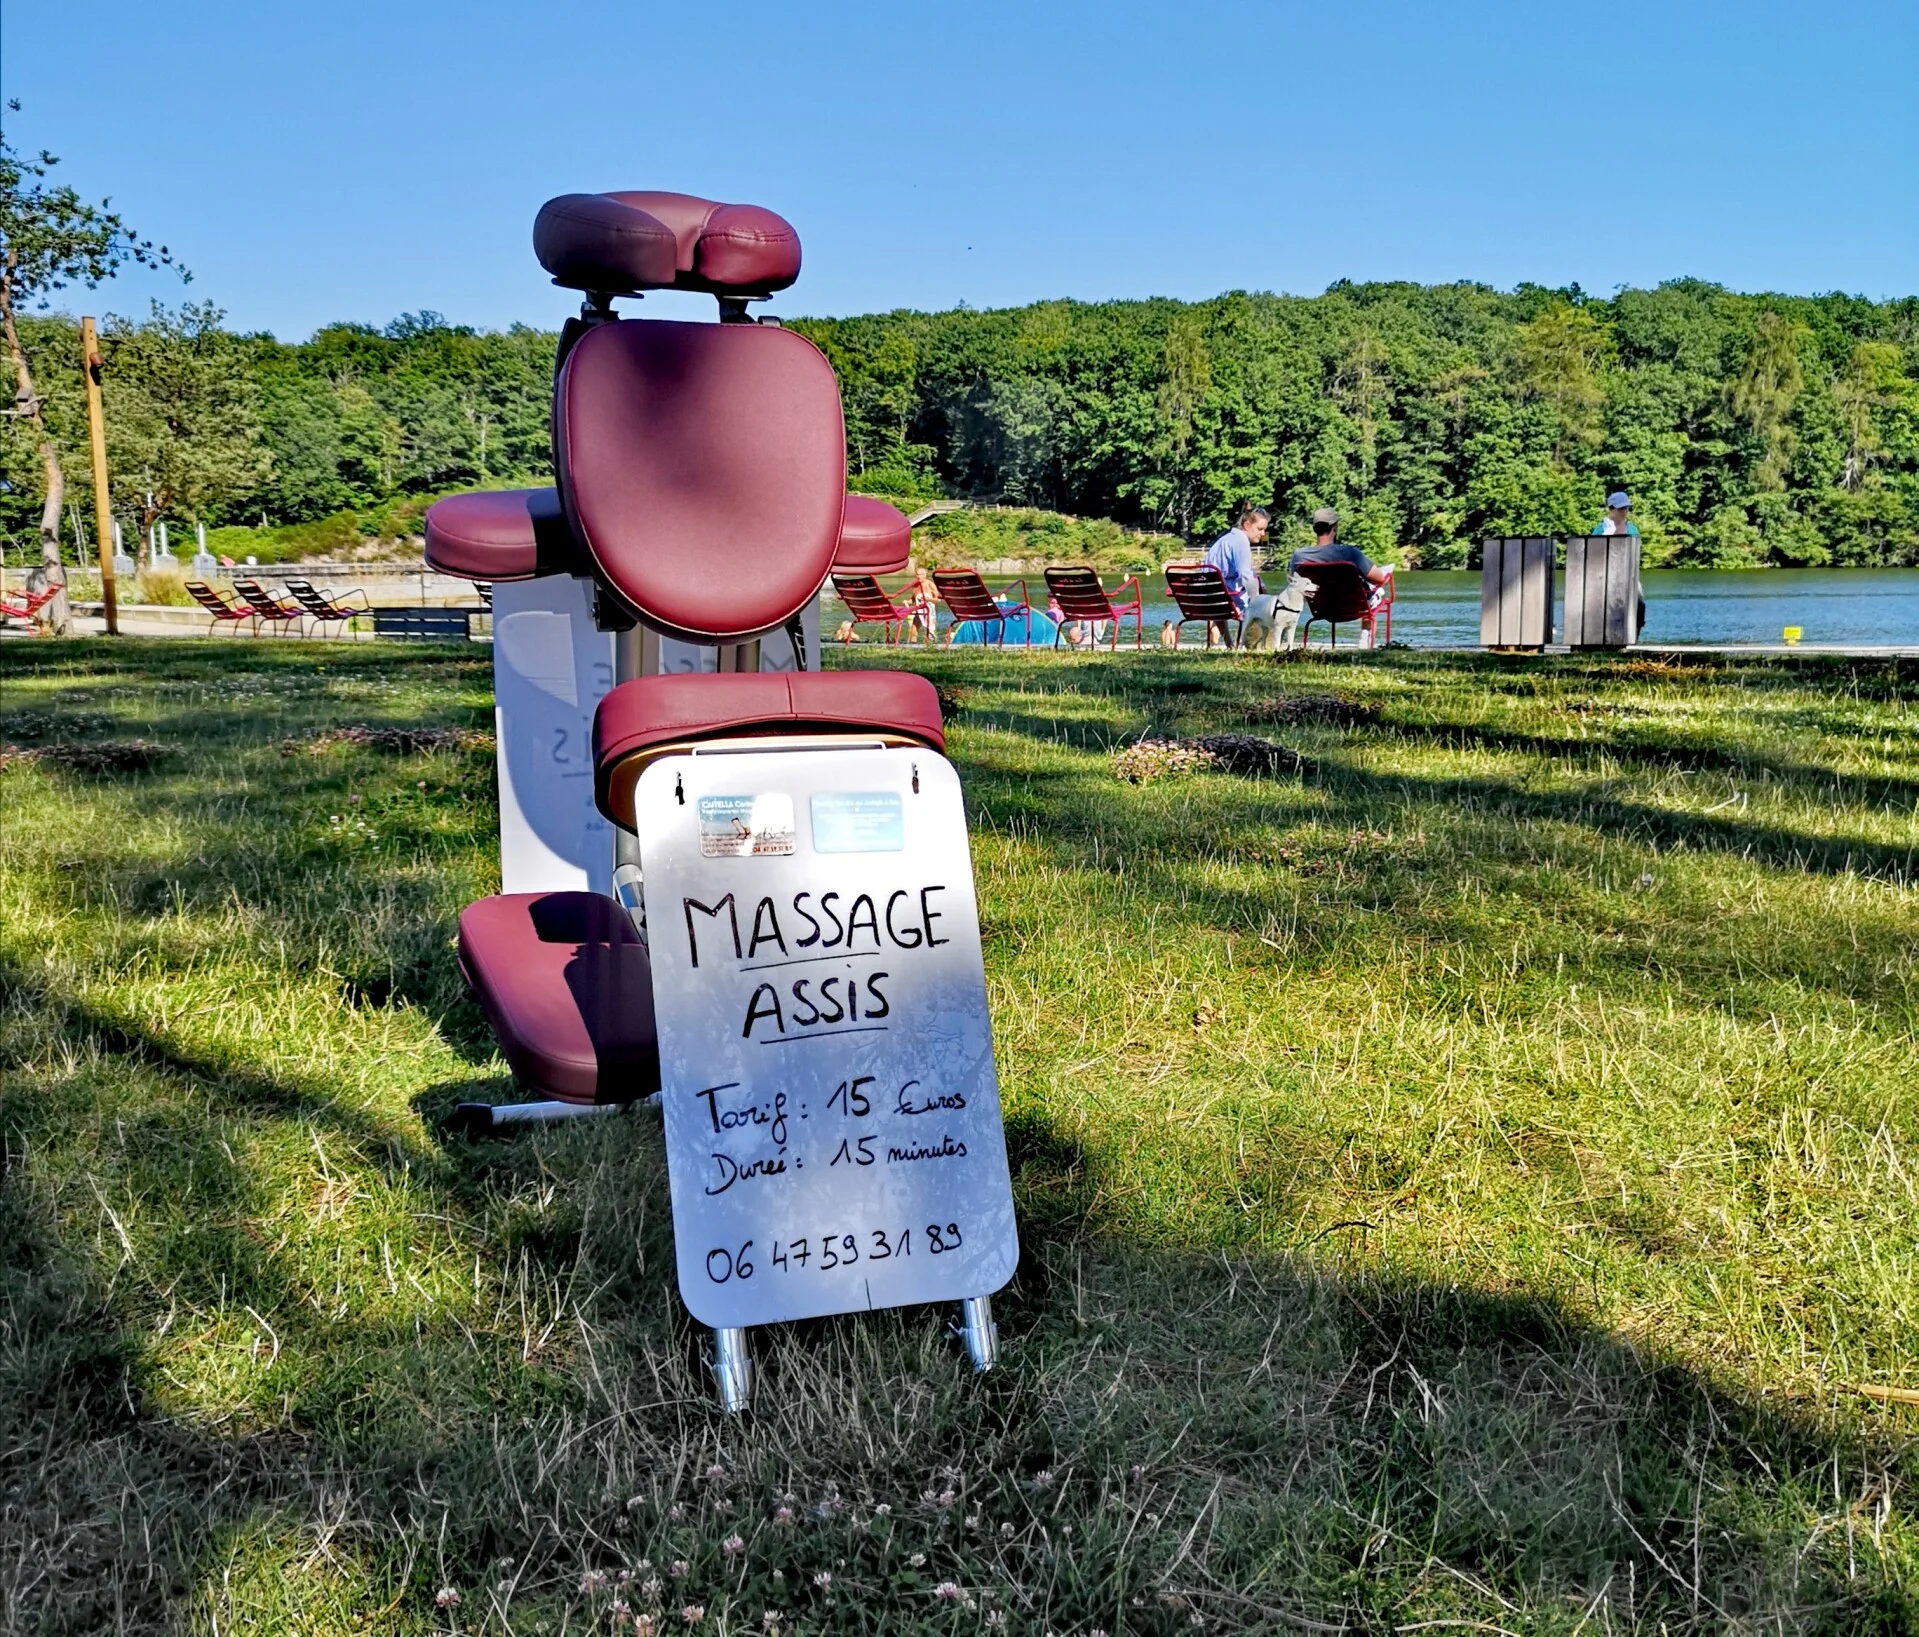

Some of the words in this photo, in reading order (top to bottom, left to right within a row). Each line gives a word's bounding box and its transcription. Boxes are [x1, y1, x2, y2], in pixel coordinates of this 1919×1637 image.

[683, 885, 950, 968] MASSAGE
[826, 1076, 876, 1117] 15
[830, 1134, 878, 1167] 15
[887, 1134, 967, 1164] minutes
[706, 1240, 754, 1284] 06
[869, 1228, 911, 1259] 31
[926, 1222, 962, 1254] 89
